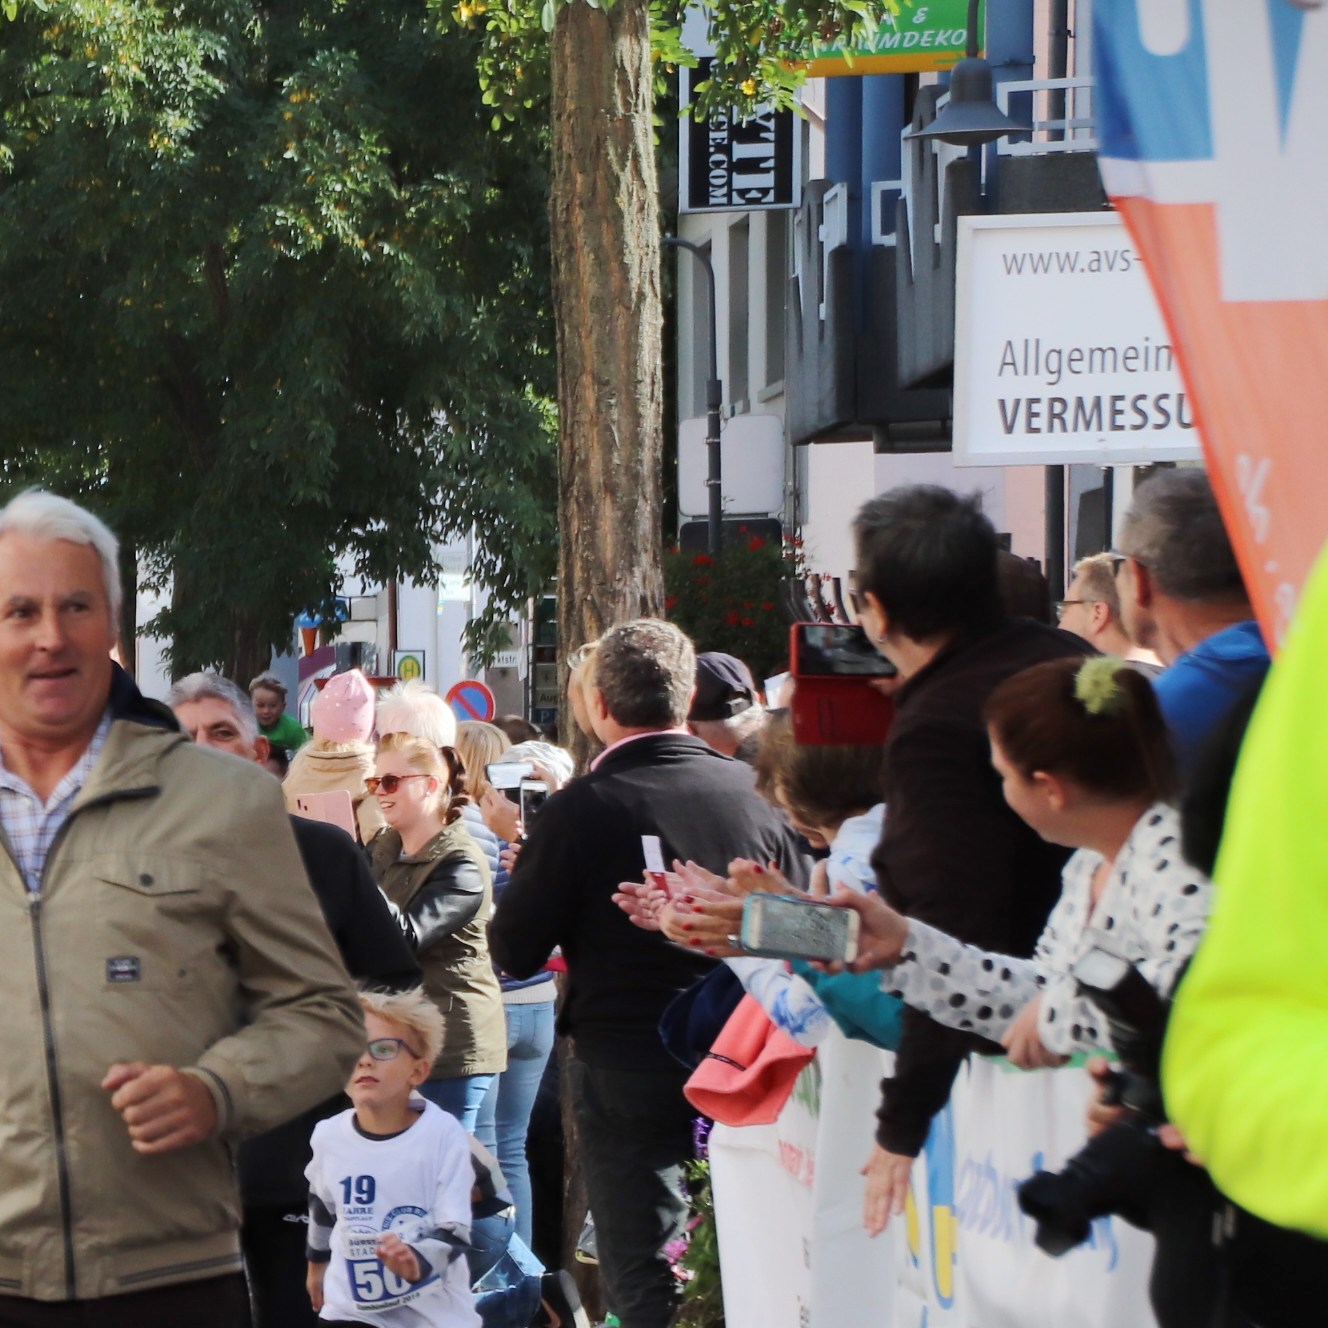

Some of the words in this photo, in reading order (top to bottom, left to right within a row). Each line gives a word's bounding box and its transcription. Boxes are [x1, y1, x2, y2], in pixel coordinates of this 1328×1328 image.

[997, 336, 1173, 386] Allgemein
[339, 1174, 376, 1205] 19
[350, 1247, 377, 1257] STAD
